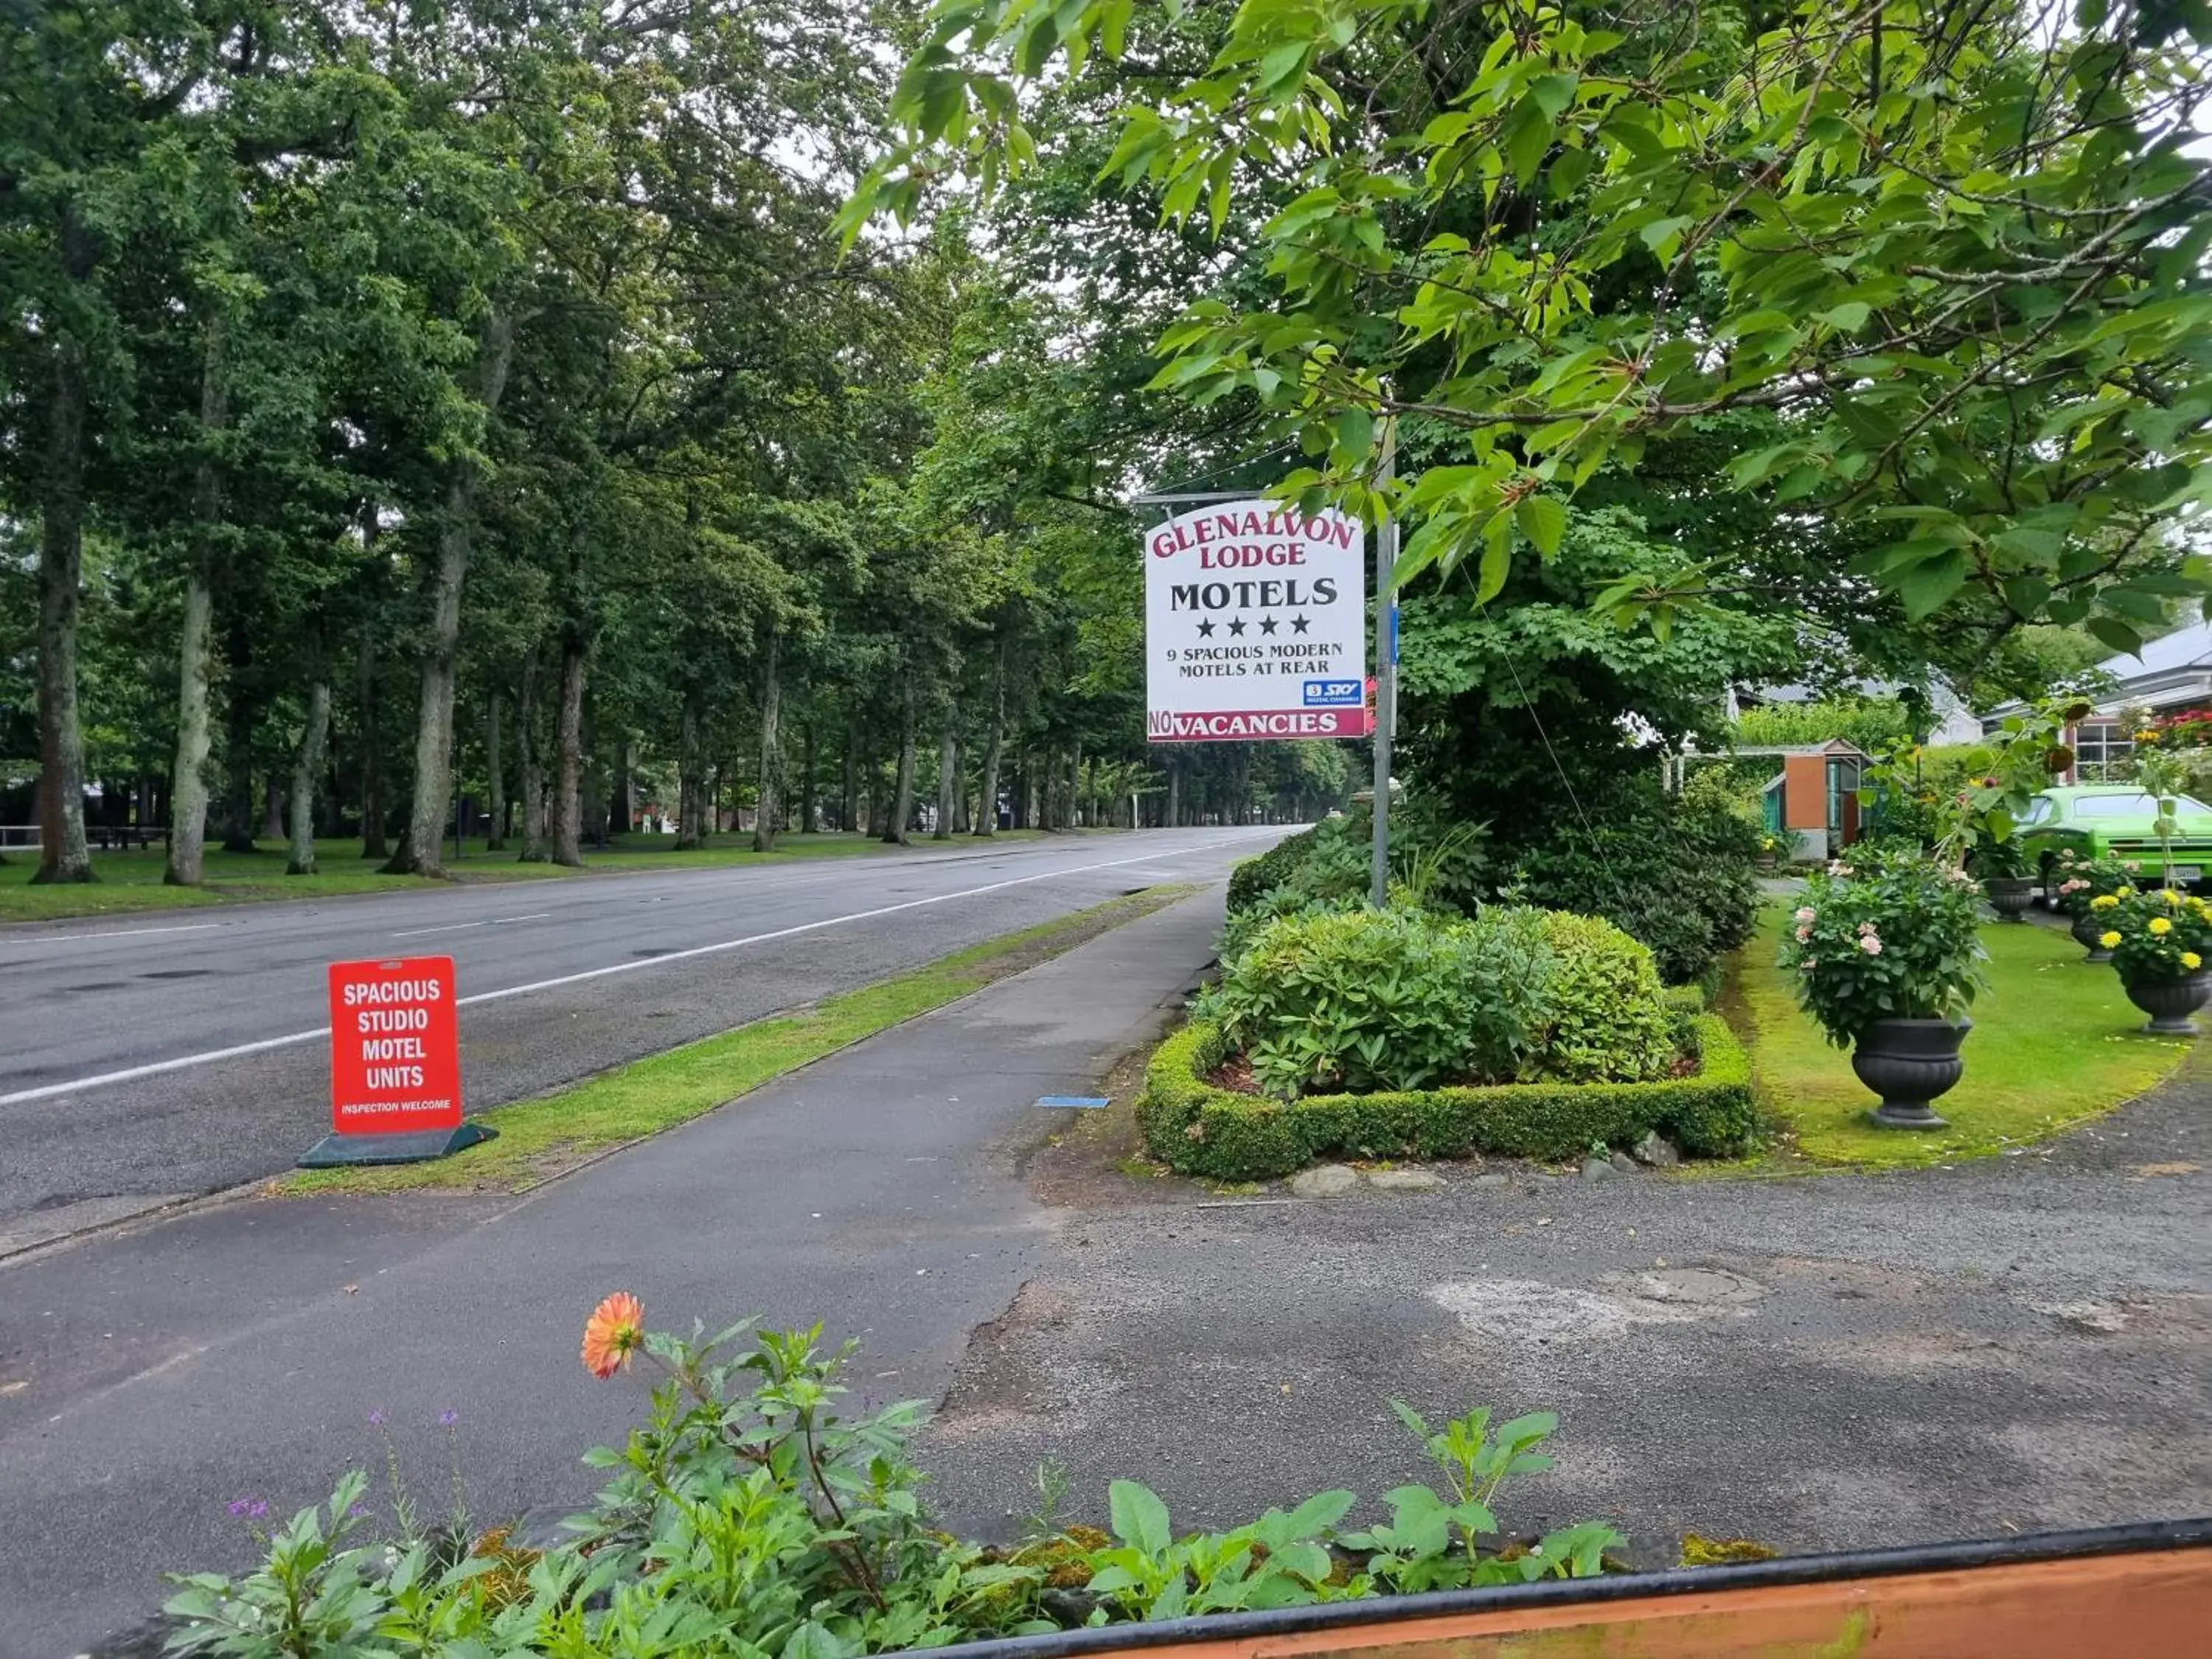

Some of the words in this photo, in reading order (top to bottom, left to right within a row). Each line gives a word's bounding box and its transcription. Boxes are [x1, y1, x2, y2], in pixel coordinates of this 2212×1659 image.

[1152, 510, 1355, 558] GLENALVON
[1200, 543, 1306, 569] LODGE
[1171, 577, 1338, 611] MOTELS
[1167, 649, 1177, 661] 9
[1183, 645, 1263, 661] SPACIOUS
[1270, 643, 1343, 658] MODERN
[1180, 663, 1247, 678] MOTELS
[1253, 662, 1274, 675] AT
[1281, 660, 1329, 674] REAR
[1149, 710, 1172, 734] NO
[1172, 713, 1338, 735] VACANCIES
[344, 979, 440, 1005] SPACIOUS
[358, 1008, 428, 1032] STUDIO
[362, 1037, 426, 1061] MOTEL
[366, 1066, 424, 1089] UNITS
[341, 1102, 398, 1115] INSPECTION
[401, 1099, 451, 1111] WELCOME
